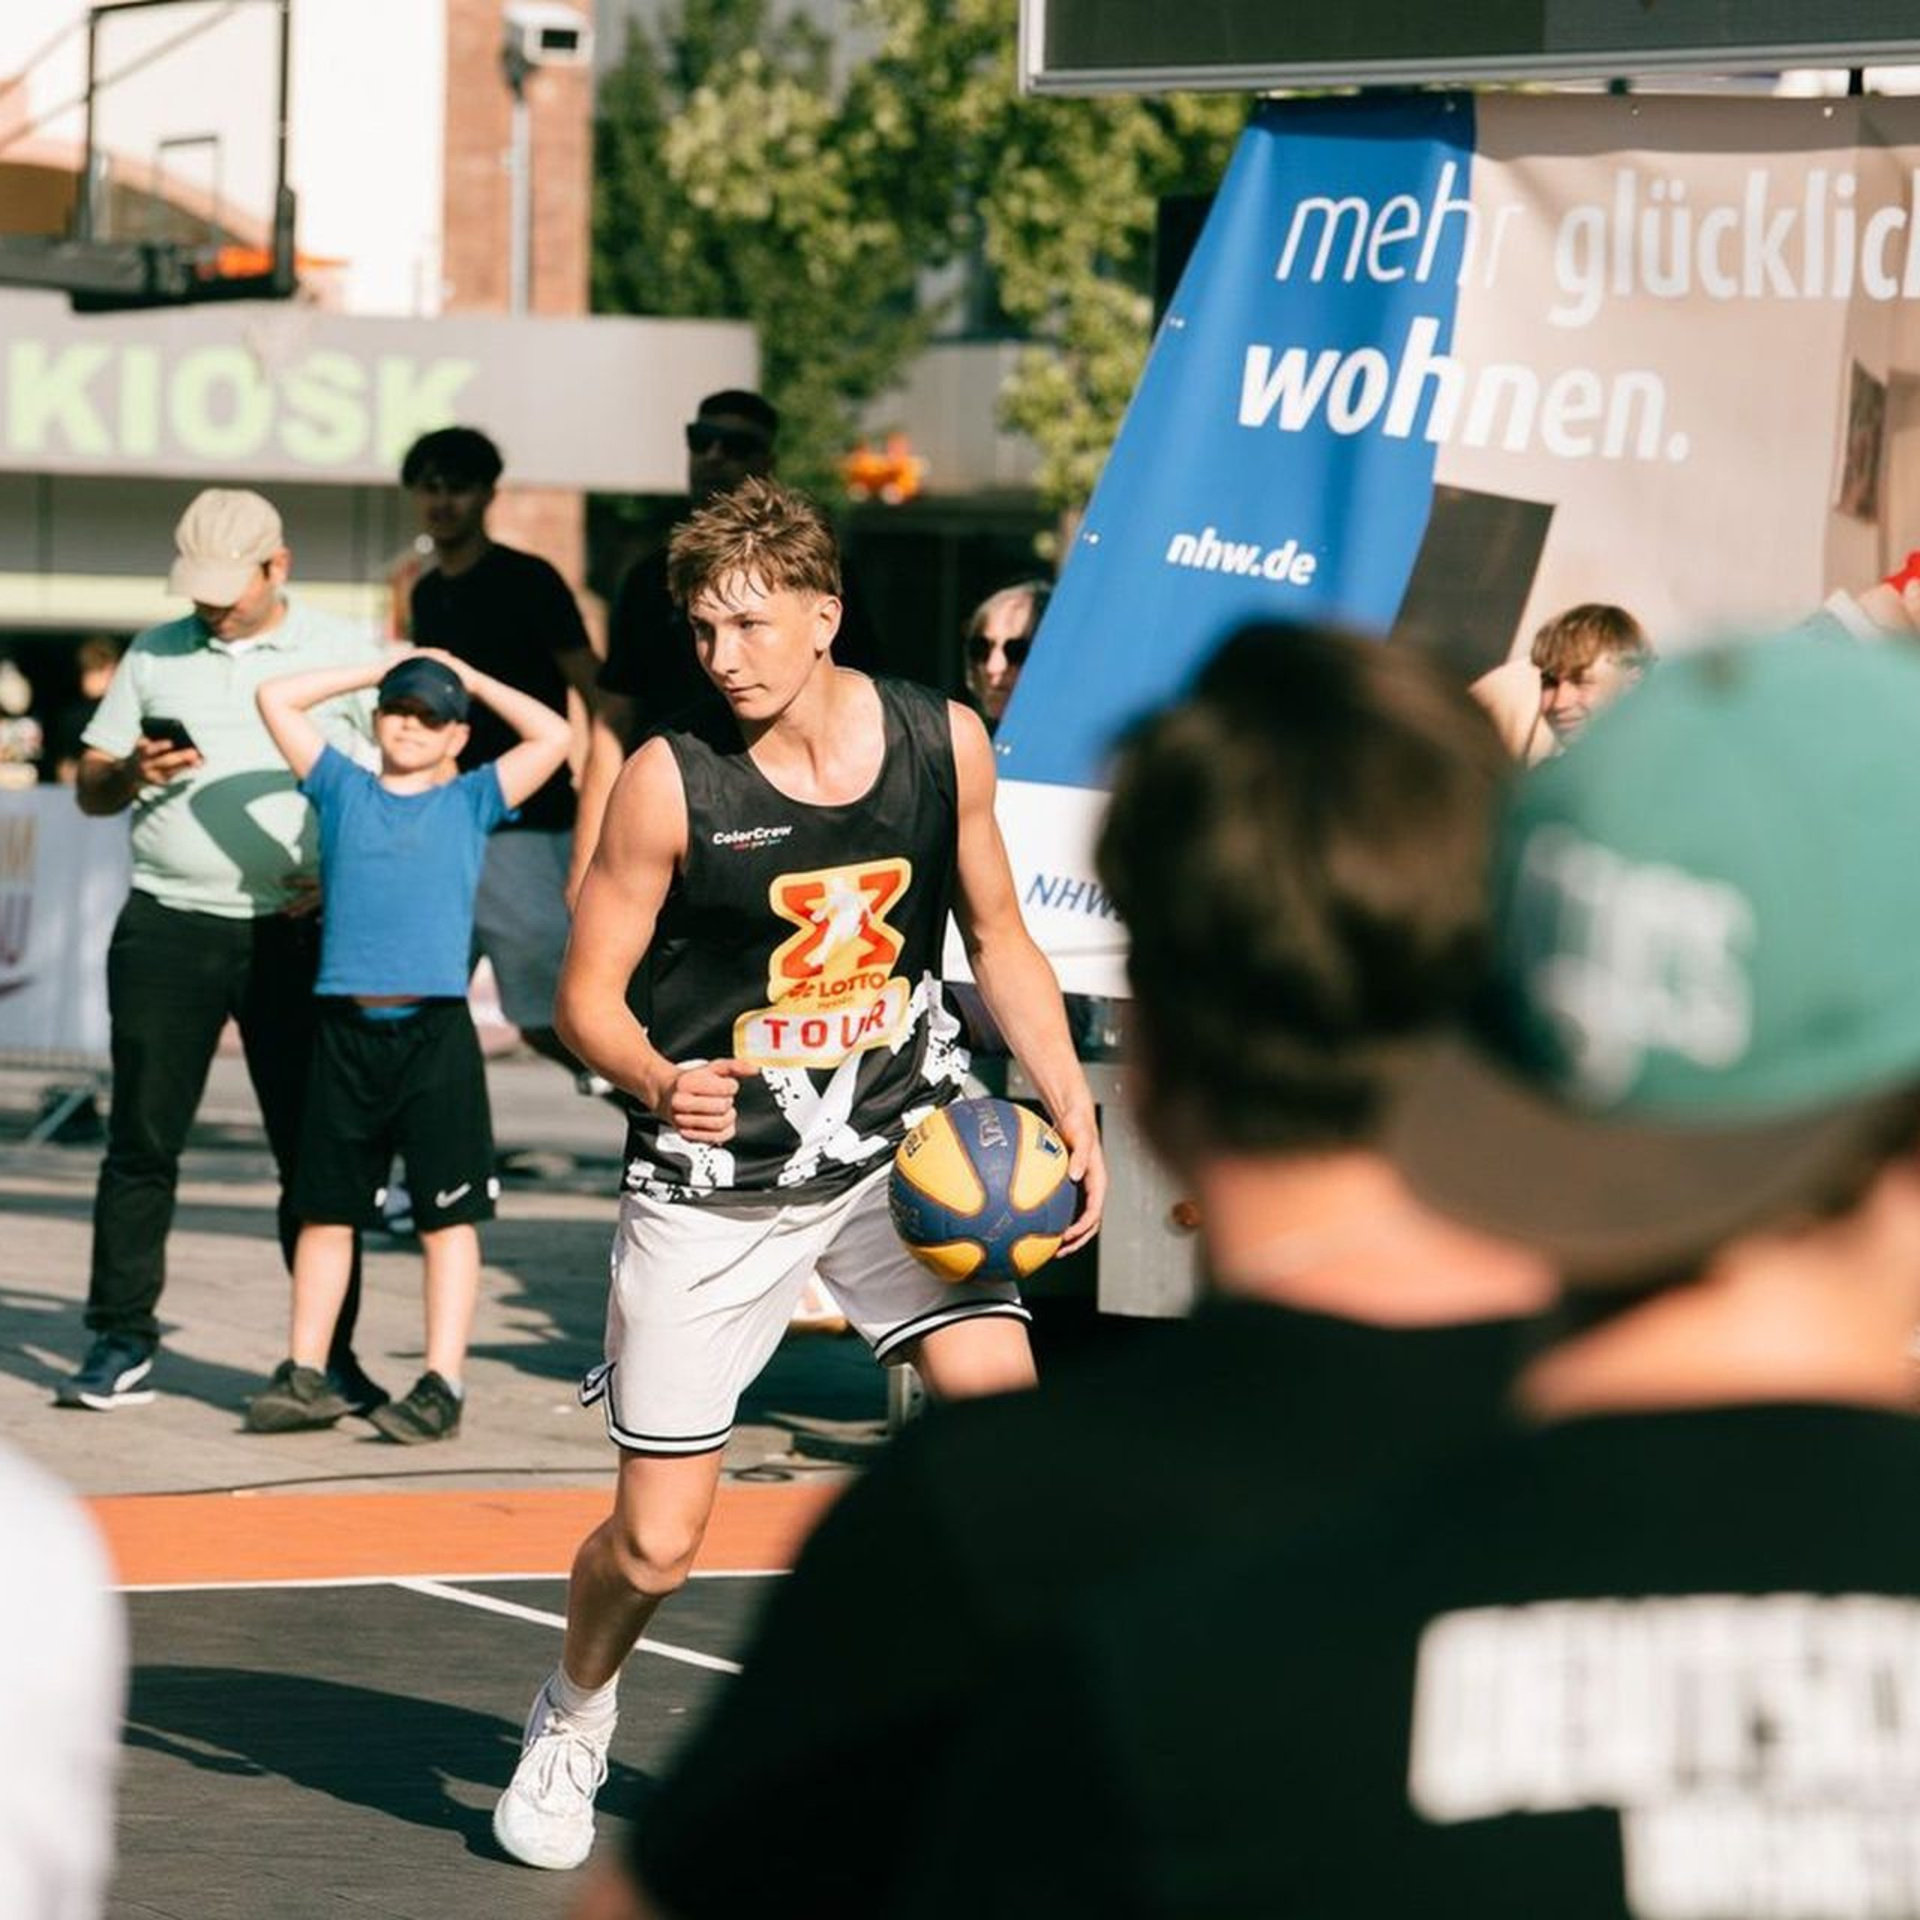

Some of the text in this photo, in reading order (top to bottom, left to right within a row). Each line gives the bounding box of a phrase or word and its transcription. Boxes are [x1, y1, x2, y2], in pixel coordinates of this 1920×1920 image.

[1276, 161, 1524, 288] mehr
[7, 338, 480, 470] KIOSK
[1239, 316, 1689, 461] wohnen.
[1166, 527, 1316, 585] nhw.de
[763, 999, 886, 1049] TOUR
[819, 972, 886, 998] LOTTO
